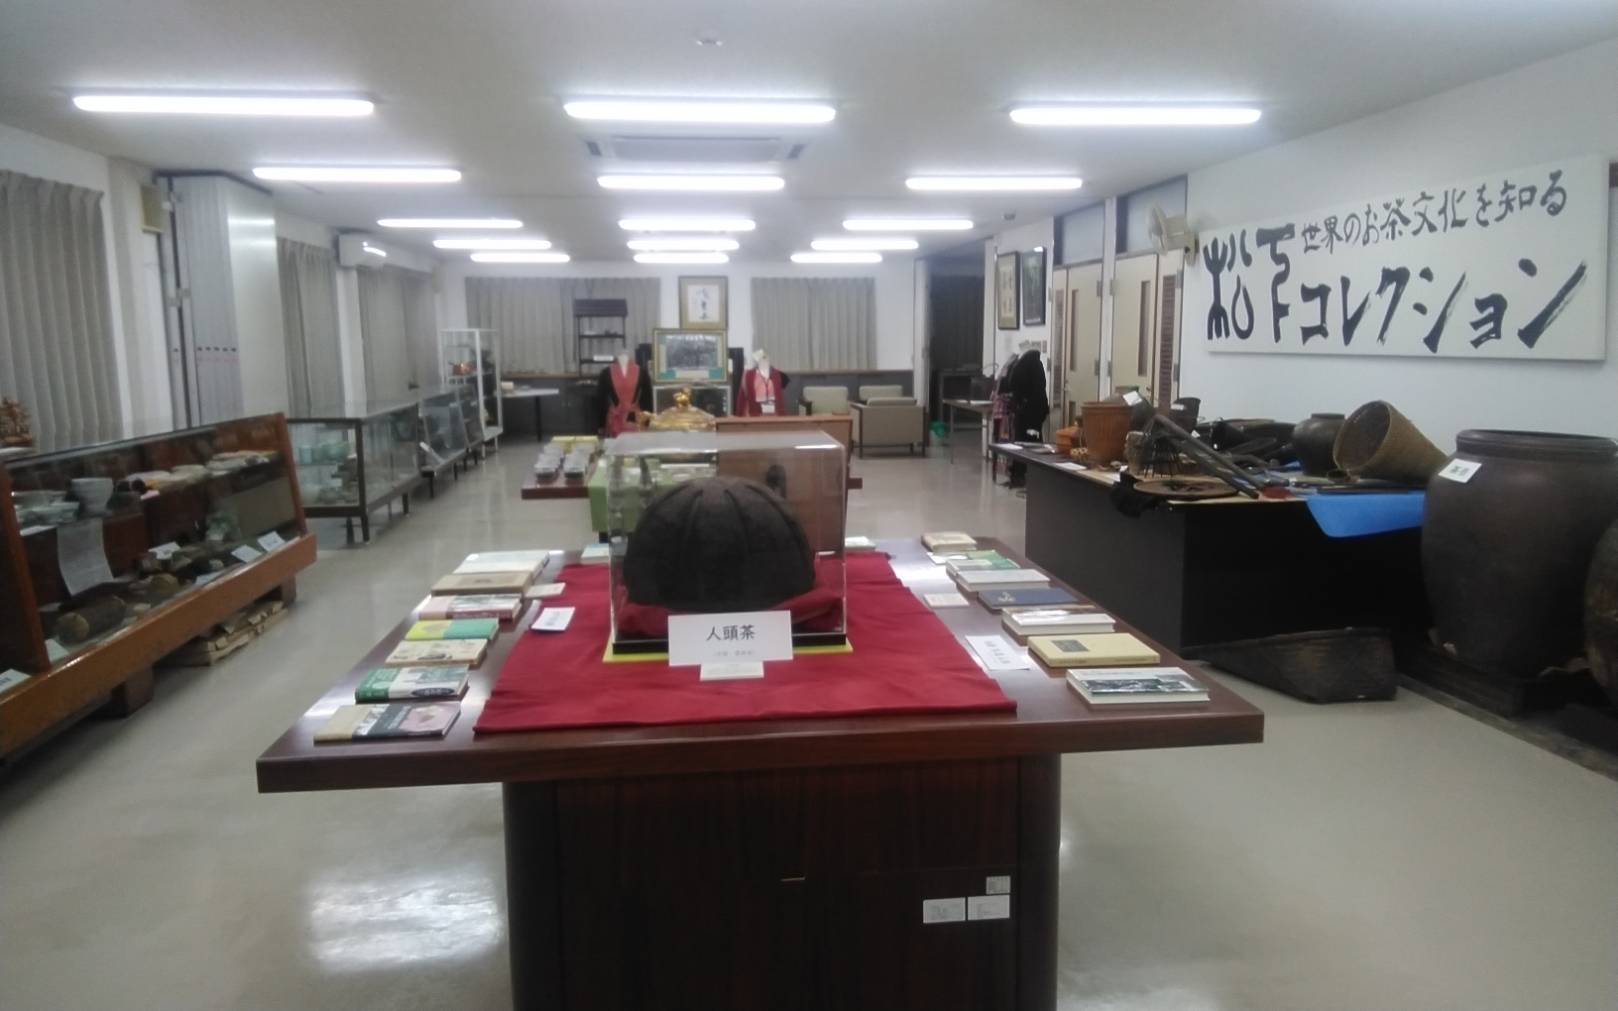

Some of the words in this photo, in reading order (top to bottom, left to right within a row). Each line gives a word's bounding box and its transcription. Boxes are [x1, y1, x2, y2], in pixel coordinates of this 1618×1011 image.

[1302, 170, 1567, 253] 世界のお茶文化を知る
[1203, 223, 1588, 354] 松下コレクション
[706, 624, 756, 641] 人頭茶
